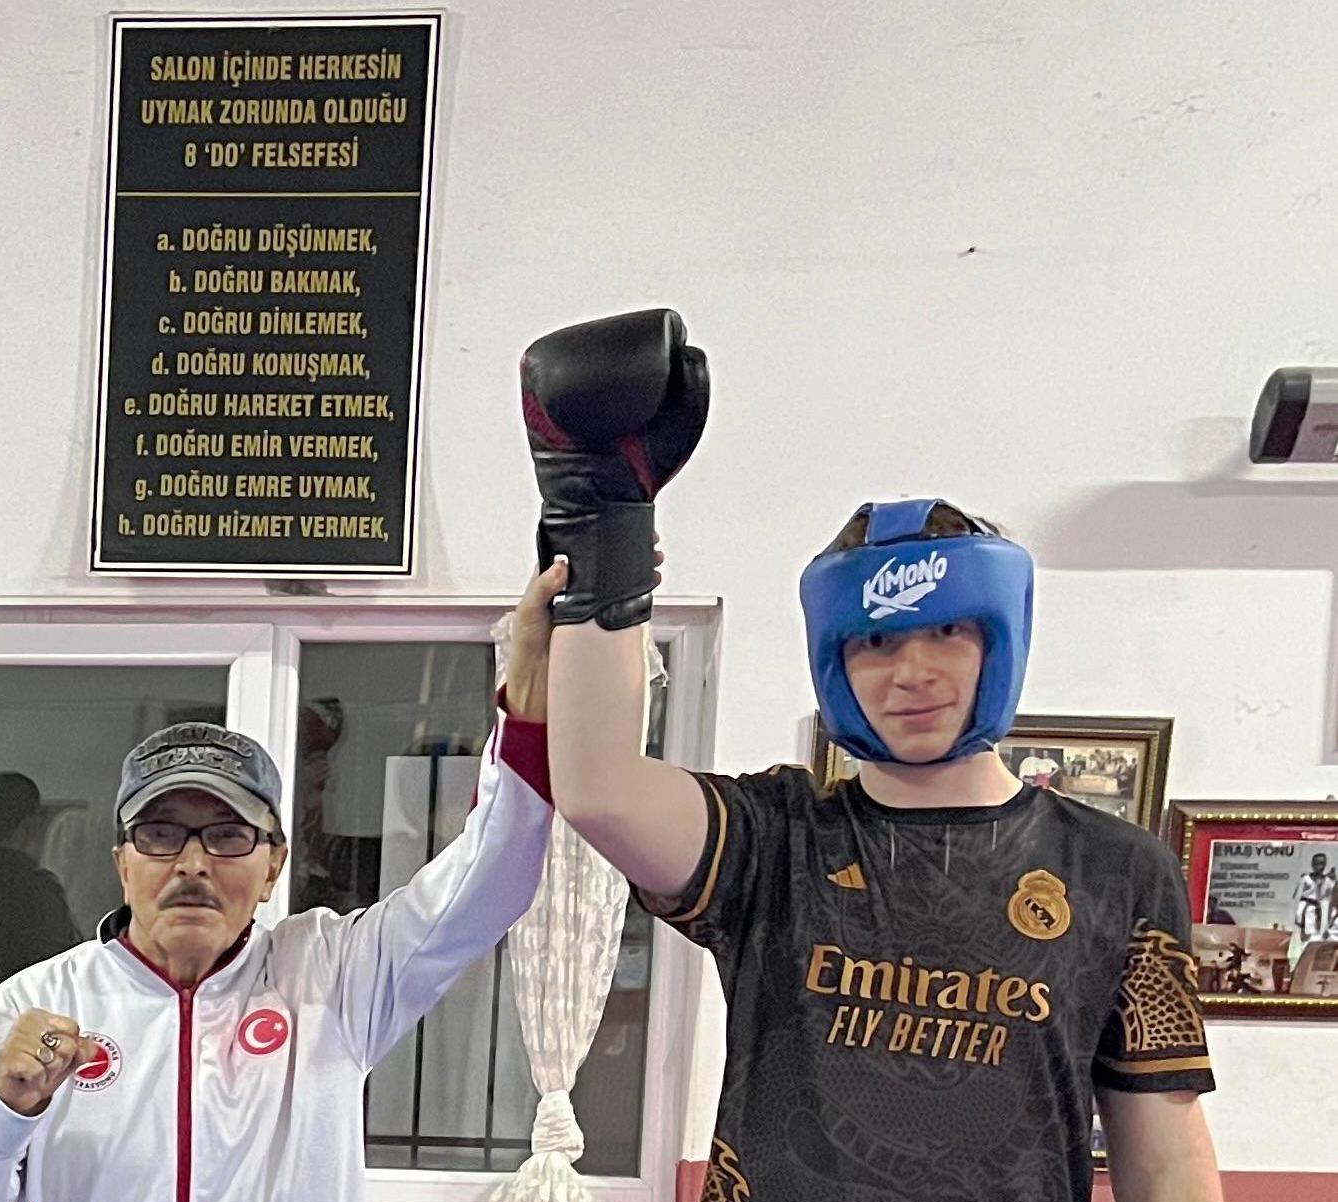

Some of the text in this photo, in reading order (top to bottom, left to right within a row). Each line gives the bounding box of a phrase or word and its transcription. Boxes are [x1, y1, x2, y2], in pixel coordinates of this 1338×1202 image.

[151, 49, 401, 87] SALON İÇİNDE HERKESİN
[141, 93, 407, 124] UYMAK ZORUNDA OLDUĞU
[184, 144, 196, 167] 8
[252, 137, 358, 167] FELSEFESİ
[157, 222, 377, 258] a. DOĞRU DÜŞÜNMEK,
[169, 264, 360, 297] b. DOĞRU BAKMAK,
[159, 306, 367, 338] c. DOĞRU DİNLEMEK,
[152, 347, 370, 381] d. DOĞRU KONUŞMAK,
[124, 388, 394, 421] e. DOĞRU HAREKET ETMEK,
[137, 429, 378, 461] f. DOĞRU EMİR VERMEK,
[135, 470, 375, 502] g. DOĞRU EMRE UYMAK,
[118, 508, 388, 542] h. DOĞRU HİZMET VERMEK,
[863, 551, 948, 619] KIMONO
[805, 943, 1051, 1022] Emirates
[827, 1005, 1009, 1067] FLY BETTER
